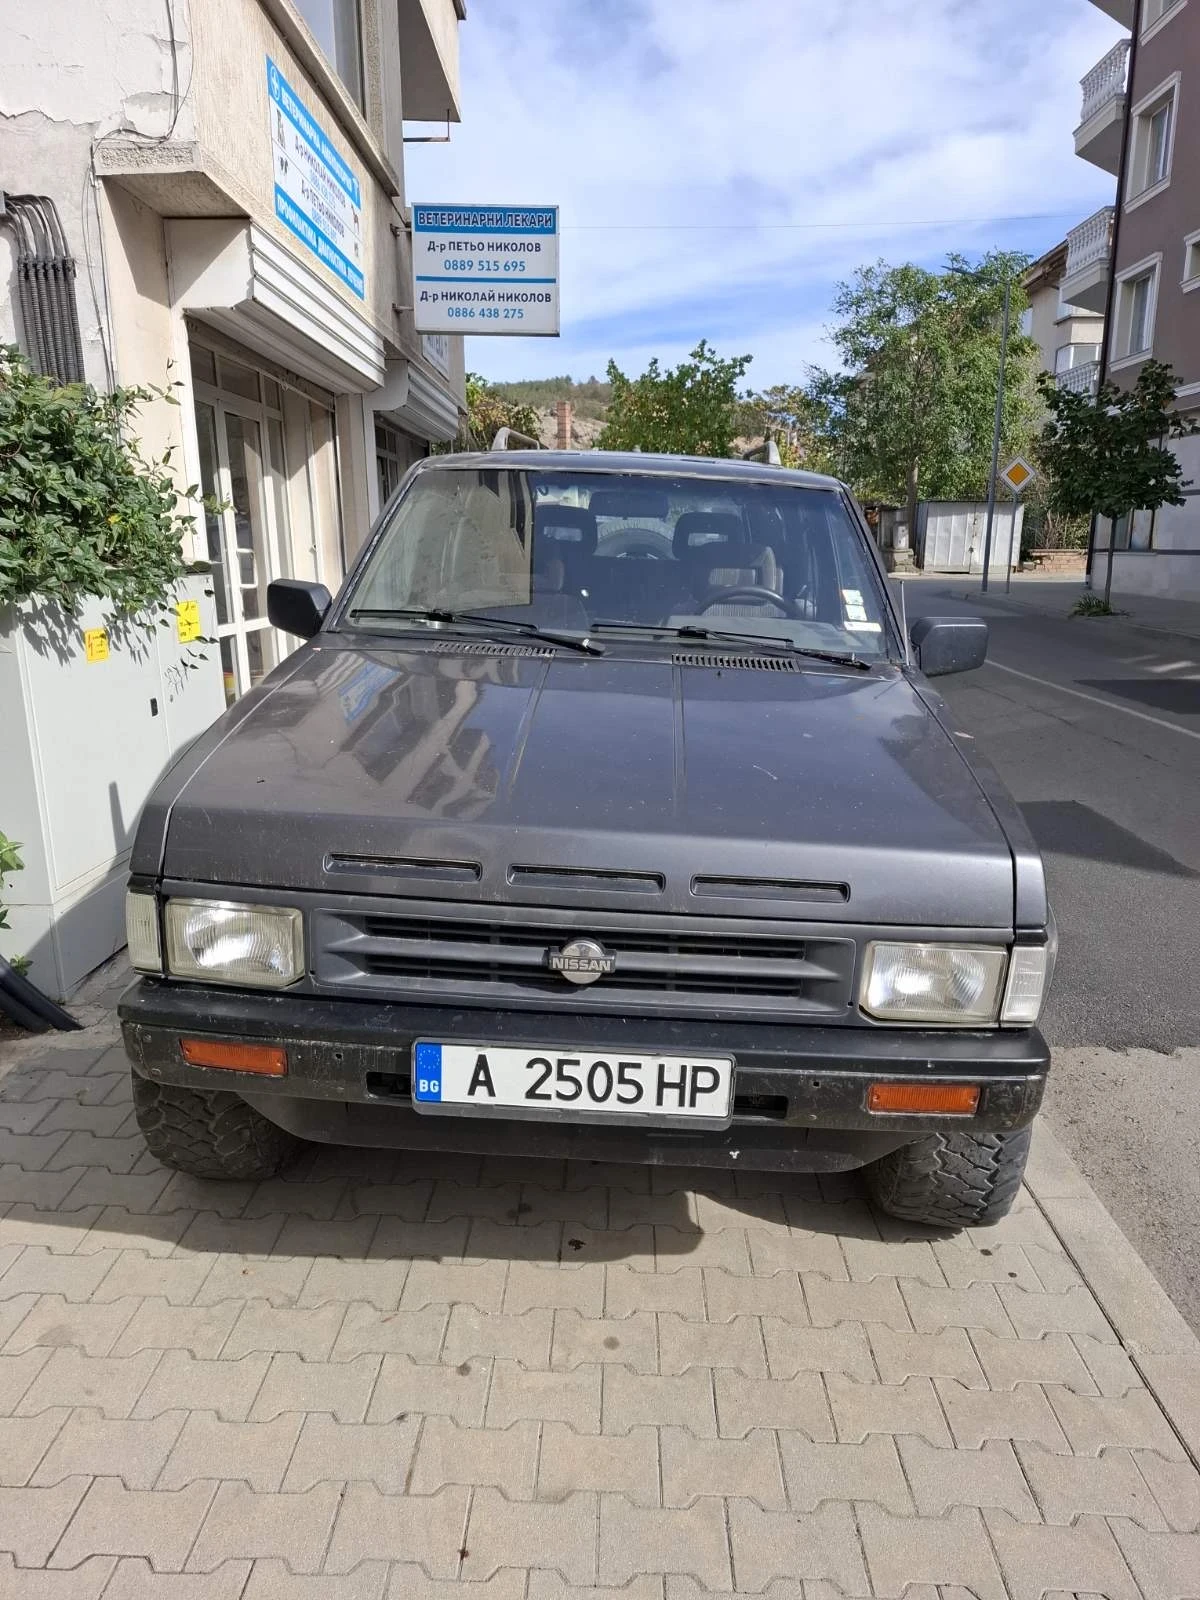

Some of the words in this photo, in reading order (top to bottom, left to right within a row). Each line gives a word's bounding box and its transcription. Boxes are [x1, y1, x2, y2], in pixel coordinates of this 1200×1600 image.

[418, 211, 503, 227] ВЕТЕРИНАРНИ
[505, 212, 552, 228] ЛЕКАРИ
[427, 240, 446, 253] Д-р
[449, 241, 485, 252] ПЕТЬО
[487, 242, 541, 252] НИКОЛОВ
[444, 259, 474, 271] 0889
[477, 260, 499, 271] 515
[503, 261, 526, 272] 695
[420, 290, 439, 303] Д-р
[441, 290, 495, 302] НИКОЛАЙ
[498, 292, 551, 302] НИКОЛОВ
[447, 307, 475, 318] 0886
[479, 308, 499, 318] 438
[503, 308, 524, 319] 275
[551, 956, 612, 972] NISSAN
[419, 1079, 439, 1094] BG
[467, 1054, 496, 1097] A
[524, 1057, 644, 1104] 2505
[656, 1063, 720, 1108] HP
